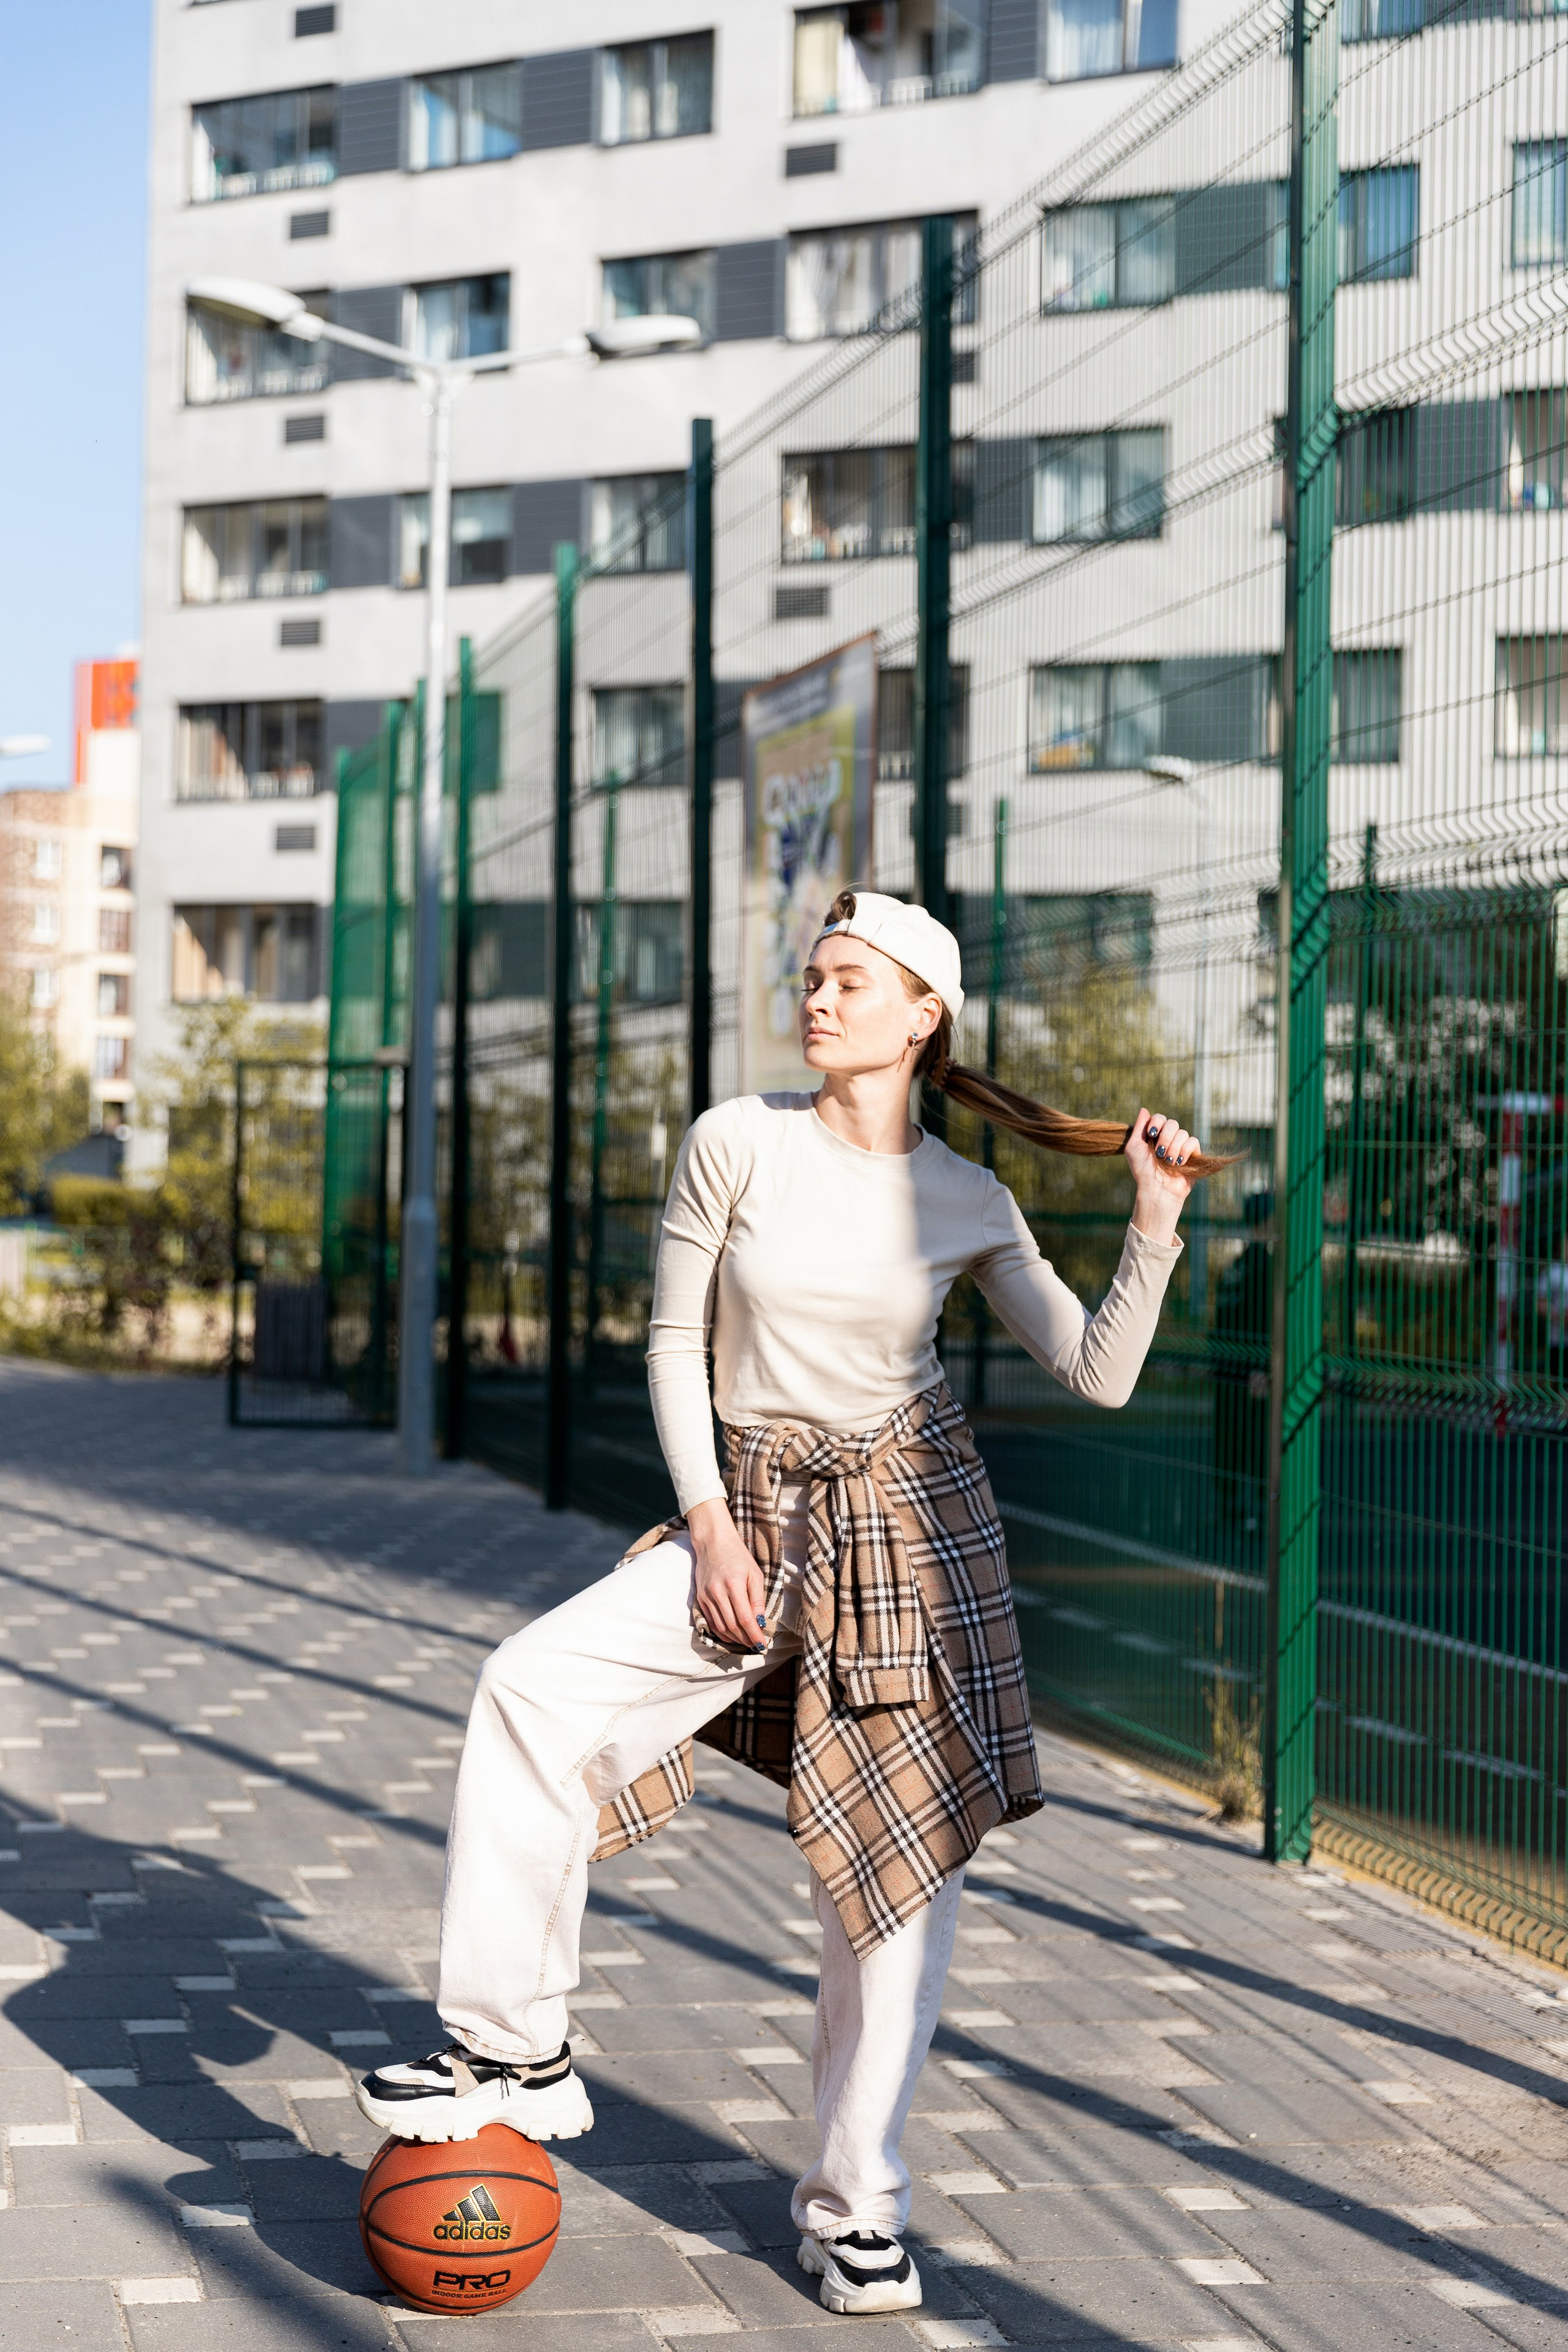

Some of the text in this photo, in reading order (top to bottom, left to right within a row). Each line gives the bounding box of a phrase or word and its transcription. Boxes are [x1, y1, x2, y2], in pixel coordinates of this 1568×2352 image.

[433, 2220, 511, 2240] adidas
[433, 2270, 511, 2290] PRO
[431, 2290, 462, 2299] INDOOR
